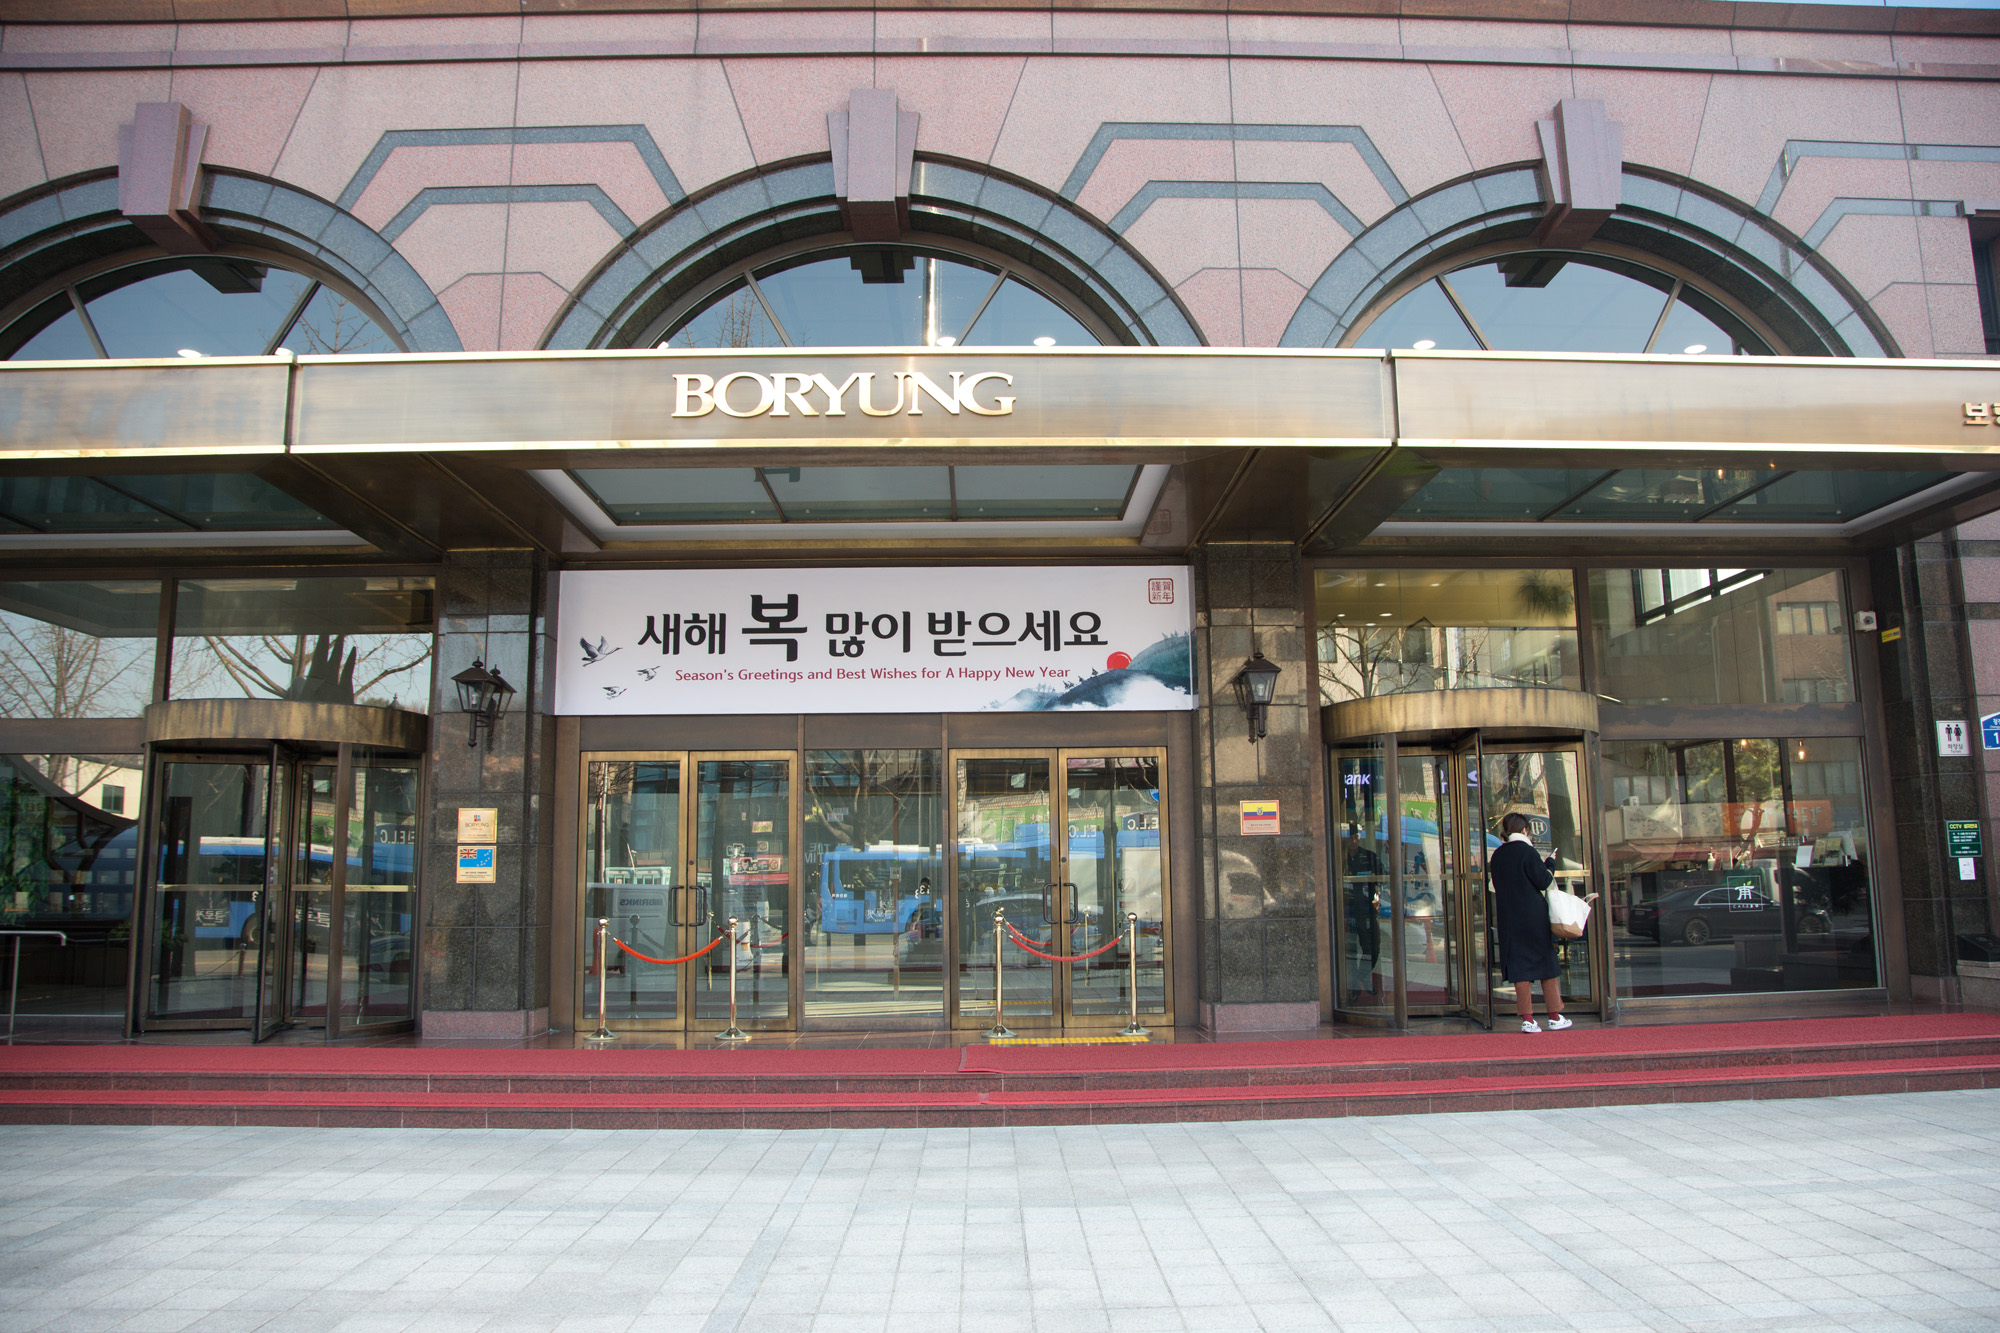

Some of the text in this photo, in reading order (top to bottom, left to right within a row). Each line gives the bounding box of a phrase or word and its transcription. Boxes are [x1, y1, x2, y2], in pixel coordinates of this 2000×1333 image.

[671, 371, 1017, 418] BORYUNG
[637, 593, 1108, 662] 새해 복 많이 받으세요
[675, 666, 1071, 684] Season's Greetings and Best Wishes for A Happy New Year
